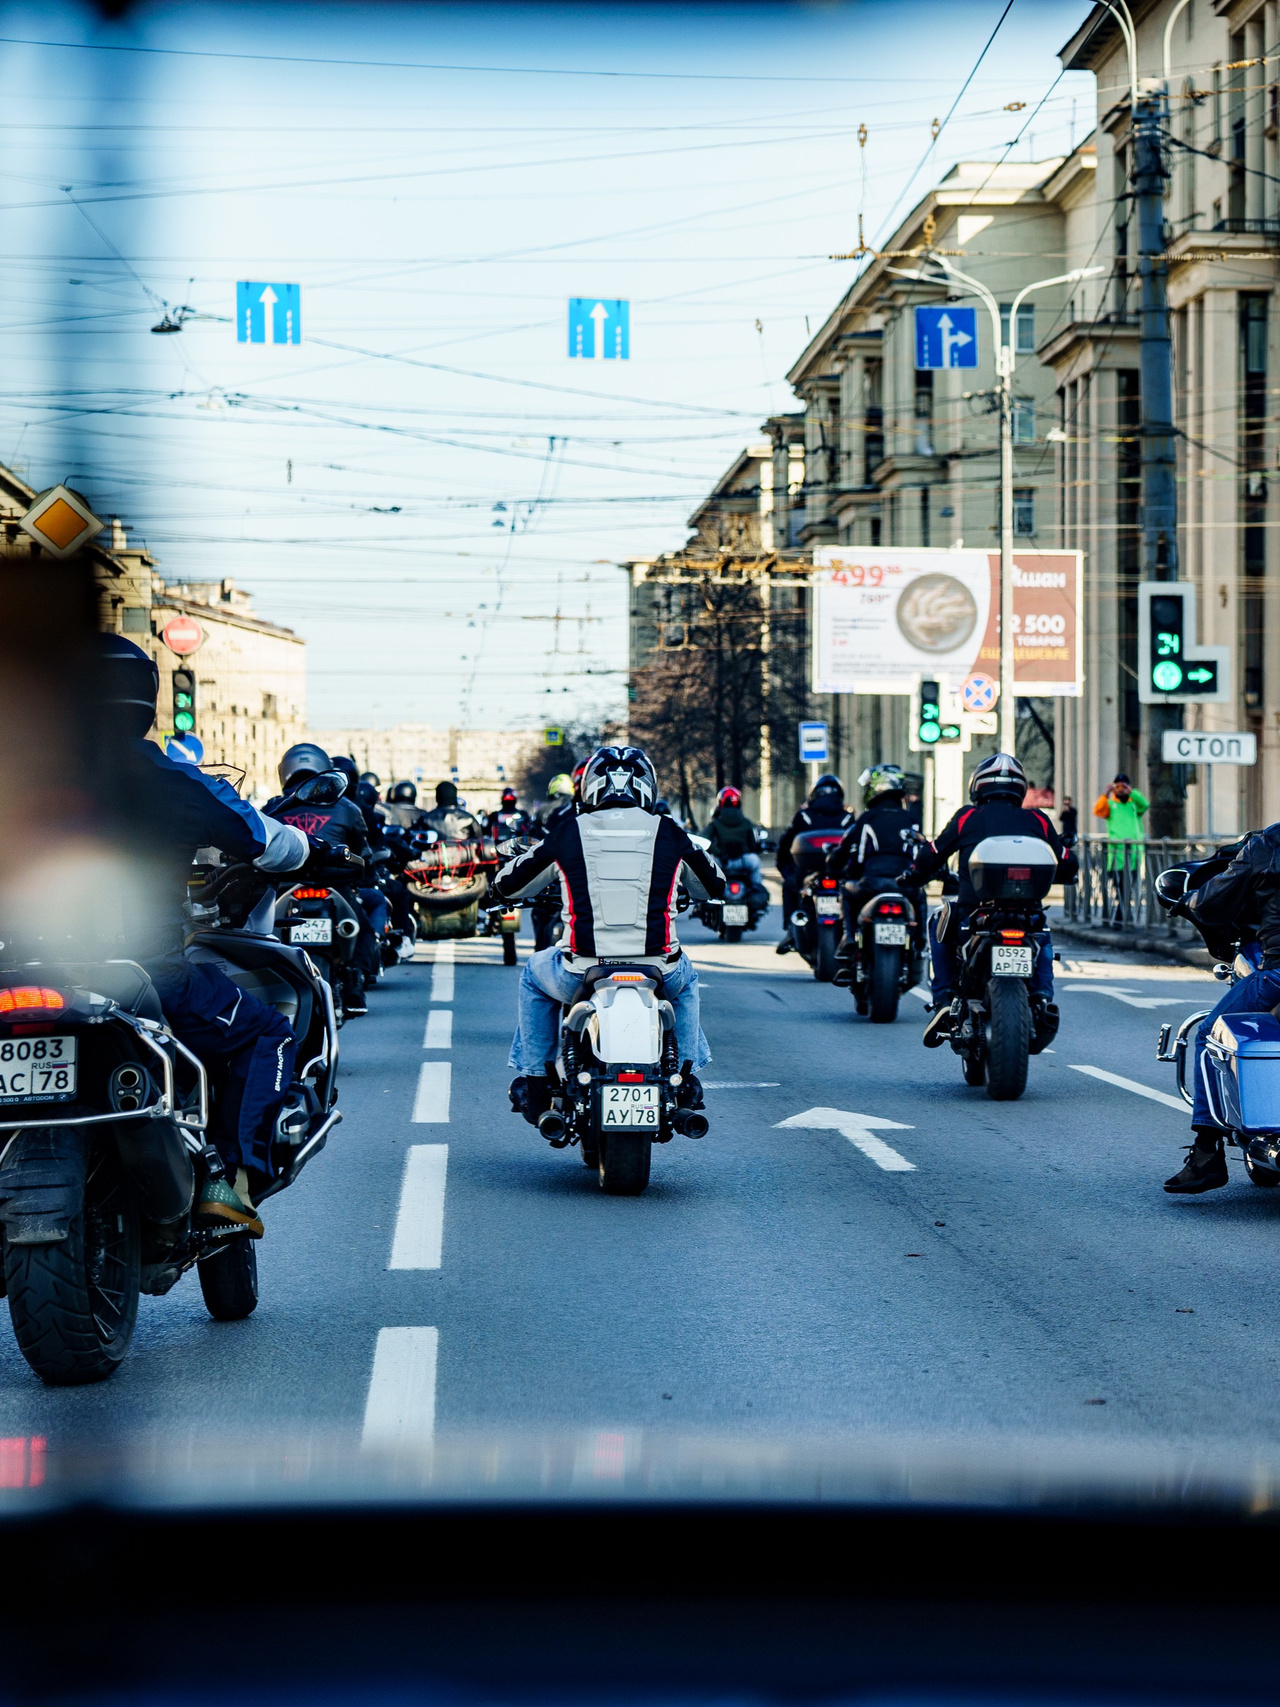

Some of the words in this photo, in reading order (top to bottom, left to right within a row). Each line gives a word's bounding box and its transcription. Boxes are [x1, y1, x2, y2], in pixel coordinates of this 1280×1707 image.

[831, 566, 884, 587] 499
[1024, 614, 1065, 634] 500
[1177, 737, 1241, 757] СТОП
[294, 933, 310, 941] АК
[315, 933, 328, 941] 78
[998, 948, 1026, 958] 0592
[995, 962, 1011, 971] АР
[1016, 962, 1029, 972] 78
[0, 1039, 63, 1061] 8083
[31, 1061, 52, 1070] RUS
[39, 1070, 69, 1091] 78
[610, 1088, 651, 1102] 2701
[606, 1109, 629, 1123] АУ
[636, 1109, 655, 1123] 78
